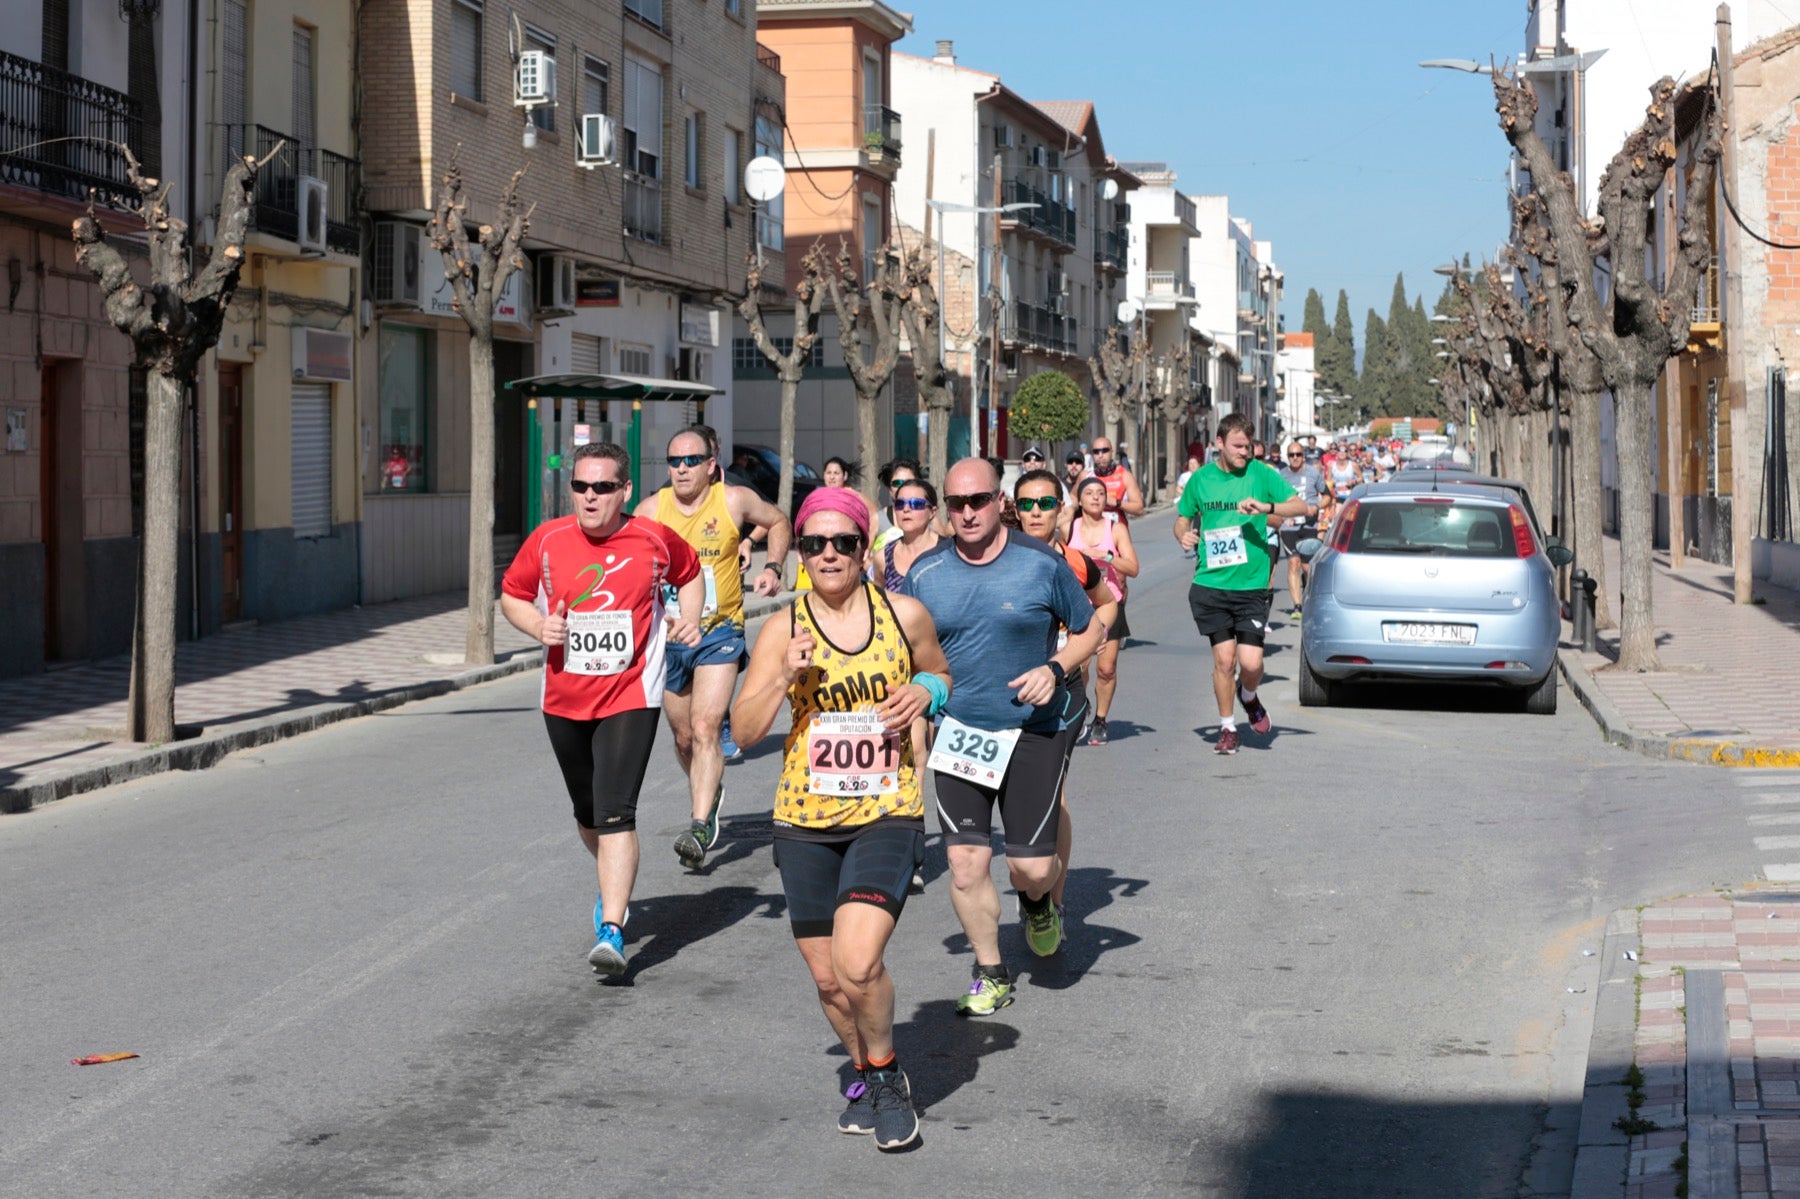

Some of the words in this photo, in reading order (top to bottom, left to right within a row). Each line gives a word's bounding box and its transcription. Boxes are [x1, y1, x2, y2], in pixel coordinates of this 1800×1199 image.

[1204, 500, 1223, 511] TEAM
[1212, 539, 1238, 555] 324
[1401, 624, 1435, 637] 7023
[1441, 625, 1466, 640] FNL
[571, 632, 627, 652] 3040
[812, 671, 888, 712] COMO
[832, 714, 847, 723] GRAN
[847, 714, 868, 723] PREMIO
[868, 714, 876, 723] DE
[814, 739, 892, 769] 2001
[948, 728, 999, 763] 329
